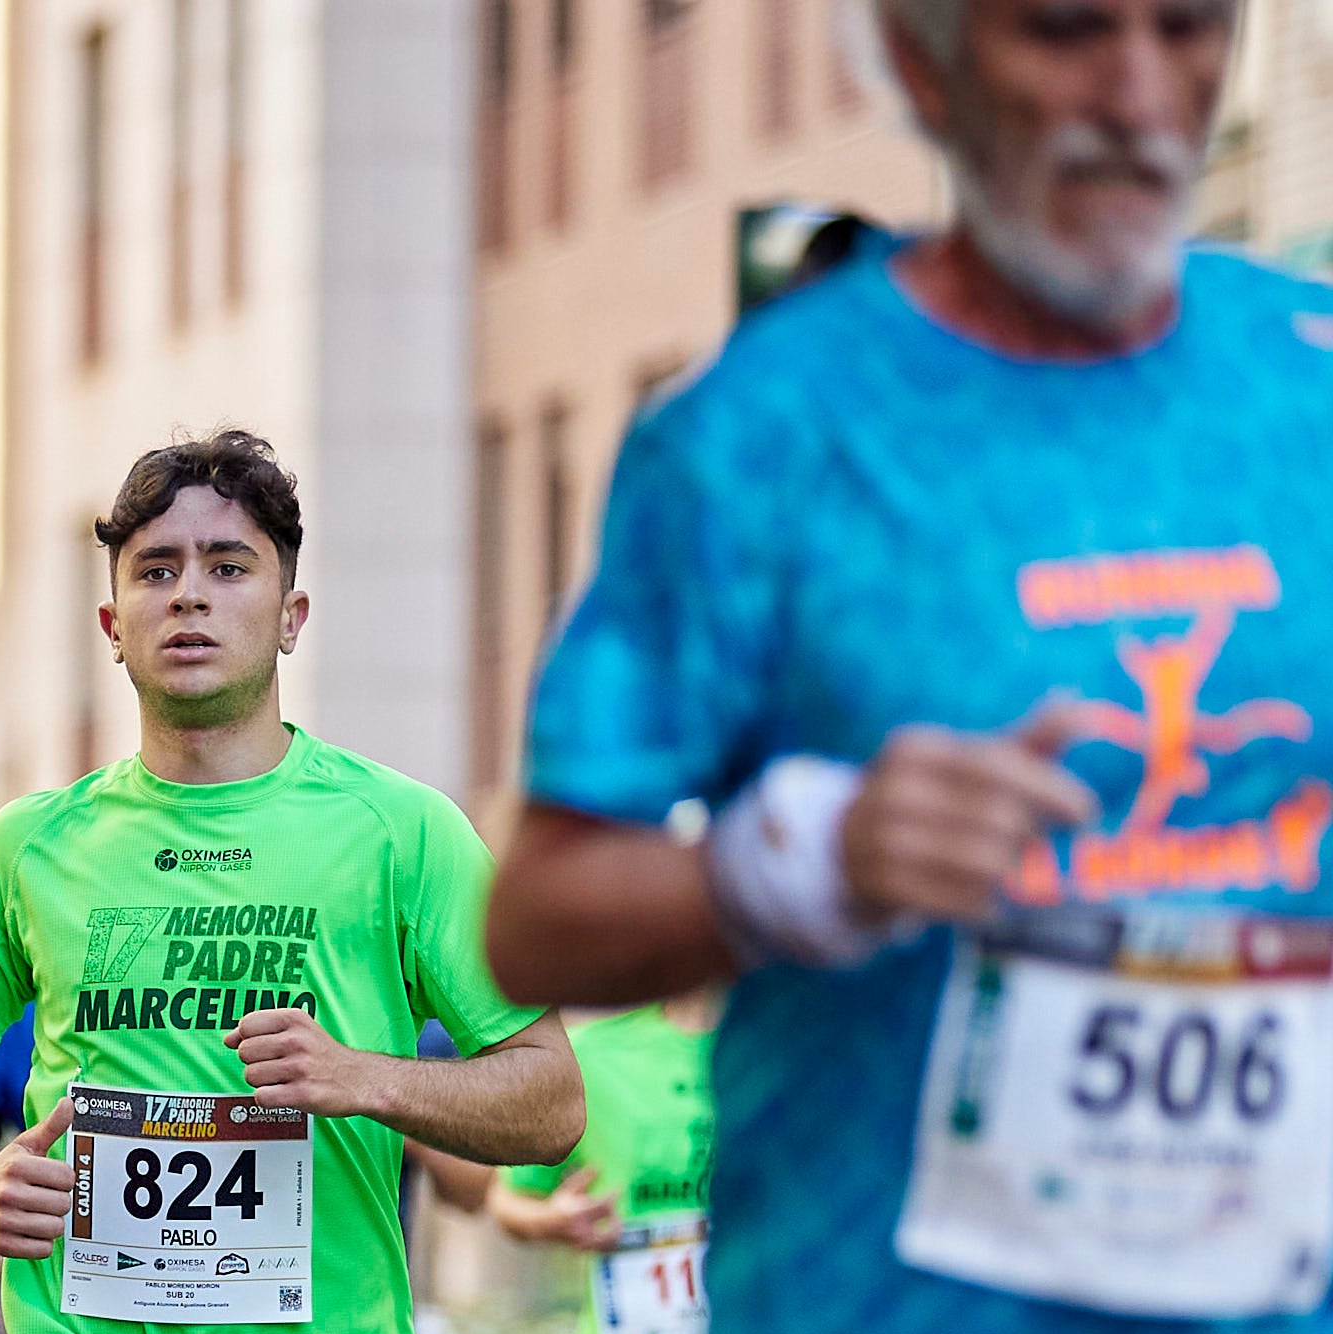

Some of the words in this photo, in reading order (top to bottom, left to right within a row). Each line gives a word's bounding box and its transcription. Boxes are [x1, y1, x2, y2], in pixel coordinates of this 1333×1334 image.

[181, 848, 252, 862] OXIMESA
[179, 863, 217, 873] NIPPON
[219, 862, 252, 872] GASES
[82, 907, 171, 984] 17
[163, 904, 318, 940] MEMORIAL
[162, 940, 308, 984] PADRE
[1068, 1006, 1288, 1122] 506
[89, 1097, 132, 1113] OXIMESA
[144, 1096, 169, 1122] 17
[168, 1097, 216, 1110] MEMORIAL
[89, 1109, 112, 1118] NIPPON
[169, 1108, 212, 1123] PADRE
[141, 1120, 217, 1139] MARCELINO
[79, 1154, 91, 1166] 4
[123, 1147, 264, 1221] 824
[76, 1169, 91, 1217] CAJÓN
[160, 1228, 217, 1247] PABLO
[74, 1252, 109, 1264] CALERO
[167, 1258, 206, 1267] OXIMESA
[165, 1291, 183, 1299] SUB
[185, 1291, 195, 1299] 20
